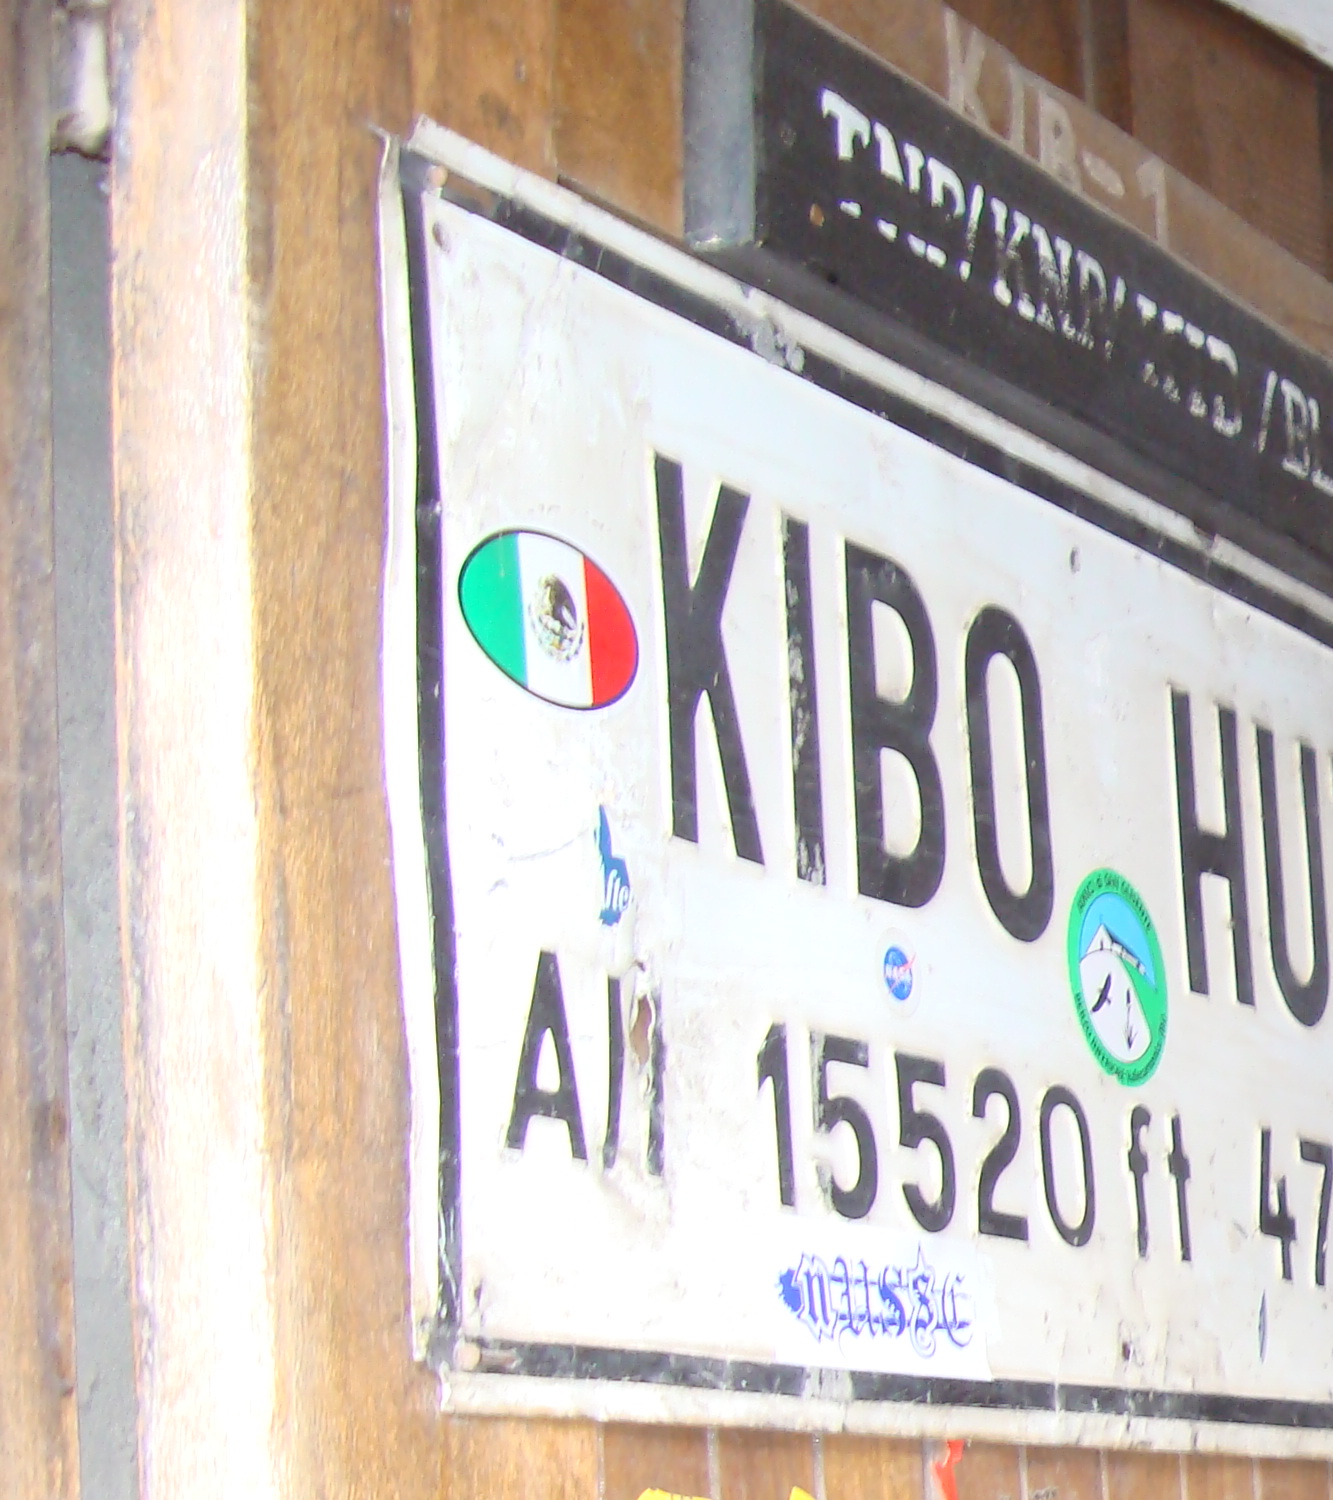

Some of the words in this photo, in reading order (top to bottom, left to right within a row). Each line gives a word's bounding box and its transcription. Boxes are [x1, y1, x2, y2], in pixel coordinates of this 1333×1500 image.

[650, 447, 1057, 945] KIBO
[756, 1020, 1098, 1248] 15520
[1127, 1106, 1193, 1263] ft
